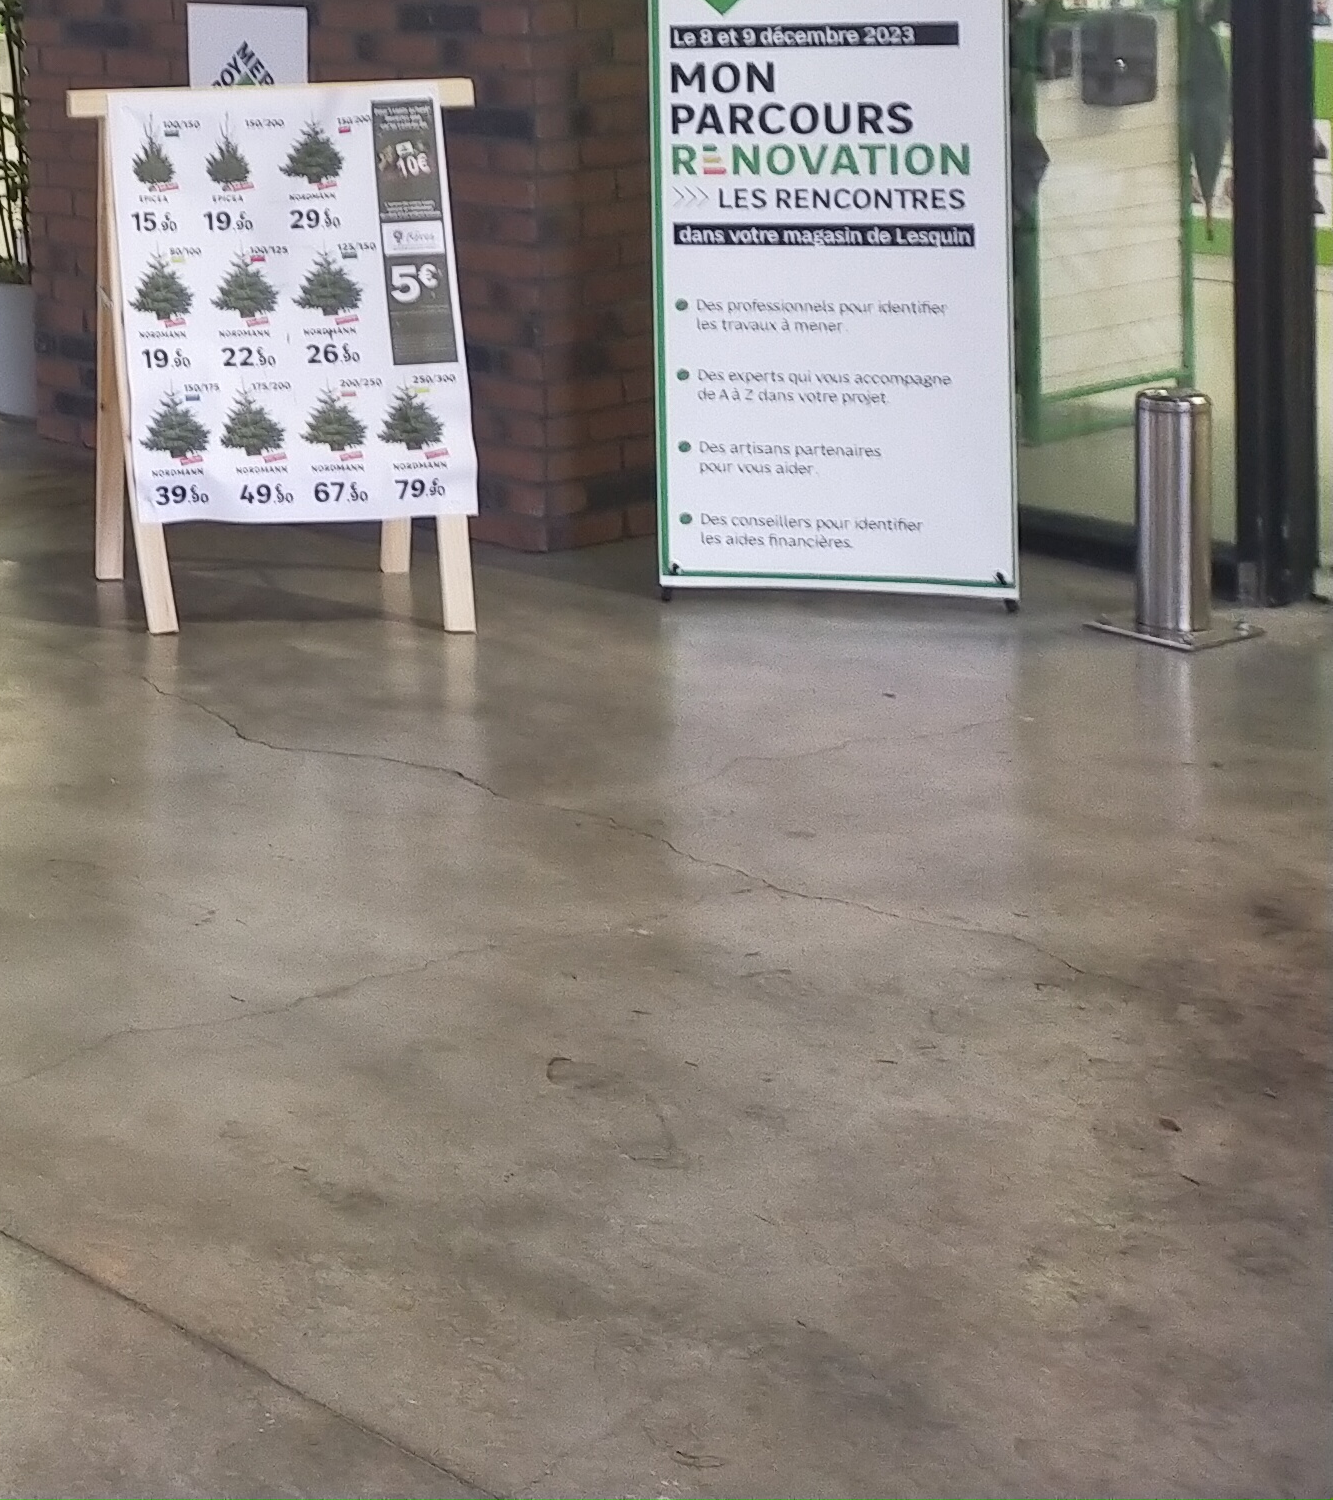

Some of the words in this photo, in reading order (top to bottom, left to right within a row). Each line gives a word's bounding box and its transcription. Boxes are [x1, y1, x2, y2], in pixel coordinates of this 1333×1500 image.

[673, 28, 696, 47] Le
[700, 28, 713, 46] 8
[717, 29, 738, 46] et
[742, 28, 756, 46] 9
[760, 25, 858, 45] décembre
[863, 26, 915, 45] 2023
[670, 61, 775, 93] MON
[671, 102, 914, 135] PARCOURS
[719, 188, 766, 209] LES
[776, 188, 966, 211] RENCONTRES
[679, 225, 725, 244] dans
[729, 227, 778, 244] votre
[783, 227, 862, 247] magasin
[867, 227, 890, 244] de
[895, 227, 971, 248] Lesquin
[391, 263, 439, 304] 5€
[696, 299, 723, 312] Des
[728, 300, 834, 314] professionnels
[839, 301, 872, 315] pour
[878, 300, 948, 317] identifier
[697, 318, 717, 331] les
[722, 319, 777, 331] travaux
[697, 369, 725, 382] Des
[729, 370, 784, 385] experts
[788, 371, 812, 386] qui
[816, 372, 850, 384] vous
[854, 373, 952, 387] accompagne
[758, 389, 794, 402] dans
[799, 391, 838, 402] votre
[699, 441, 725, 454] Des
[730, 442, 790, 455] artisans
[795, 443, 881, 458] partenaires
[699, 461, 732, 475] pour
[737, 462, 771, 474] vous
[701, 512, 727, 526] Des
[731, 514, 811, 529] conseillers
[816, 518, 849, 531] pour
[855, 518, 923, 533] identifier
[701, 533, 721, 545] les
[725, 533, 765, 546] aides
